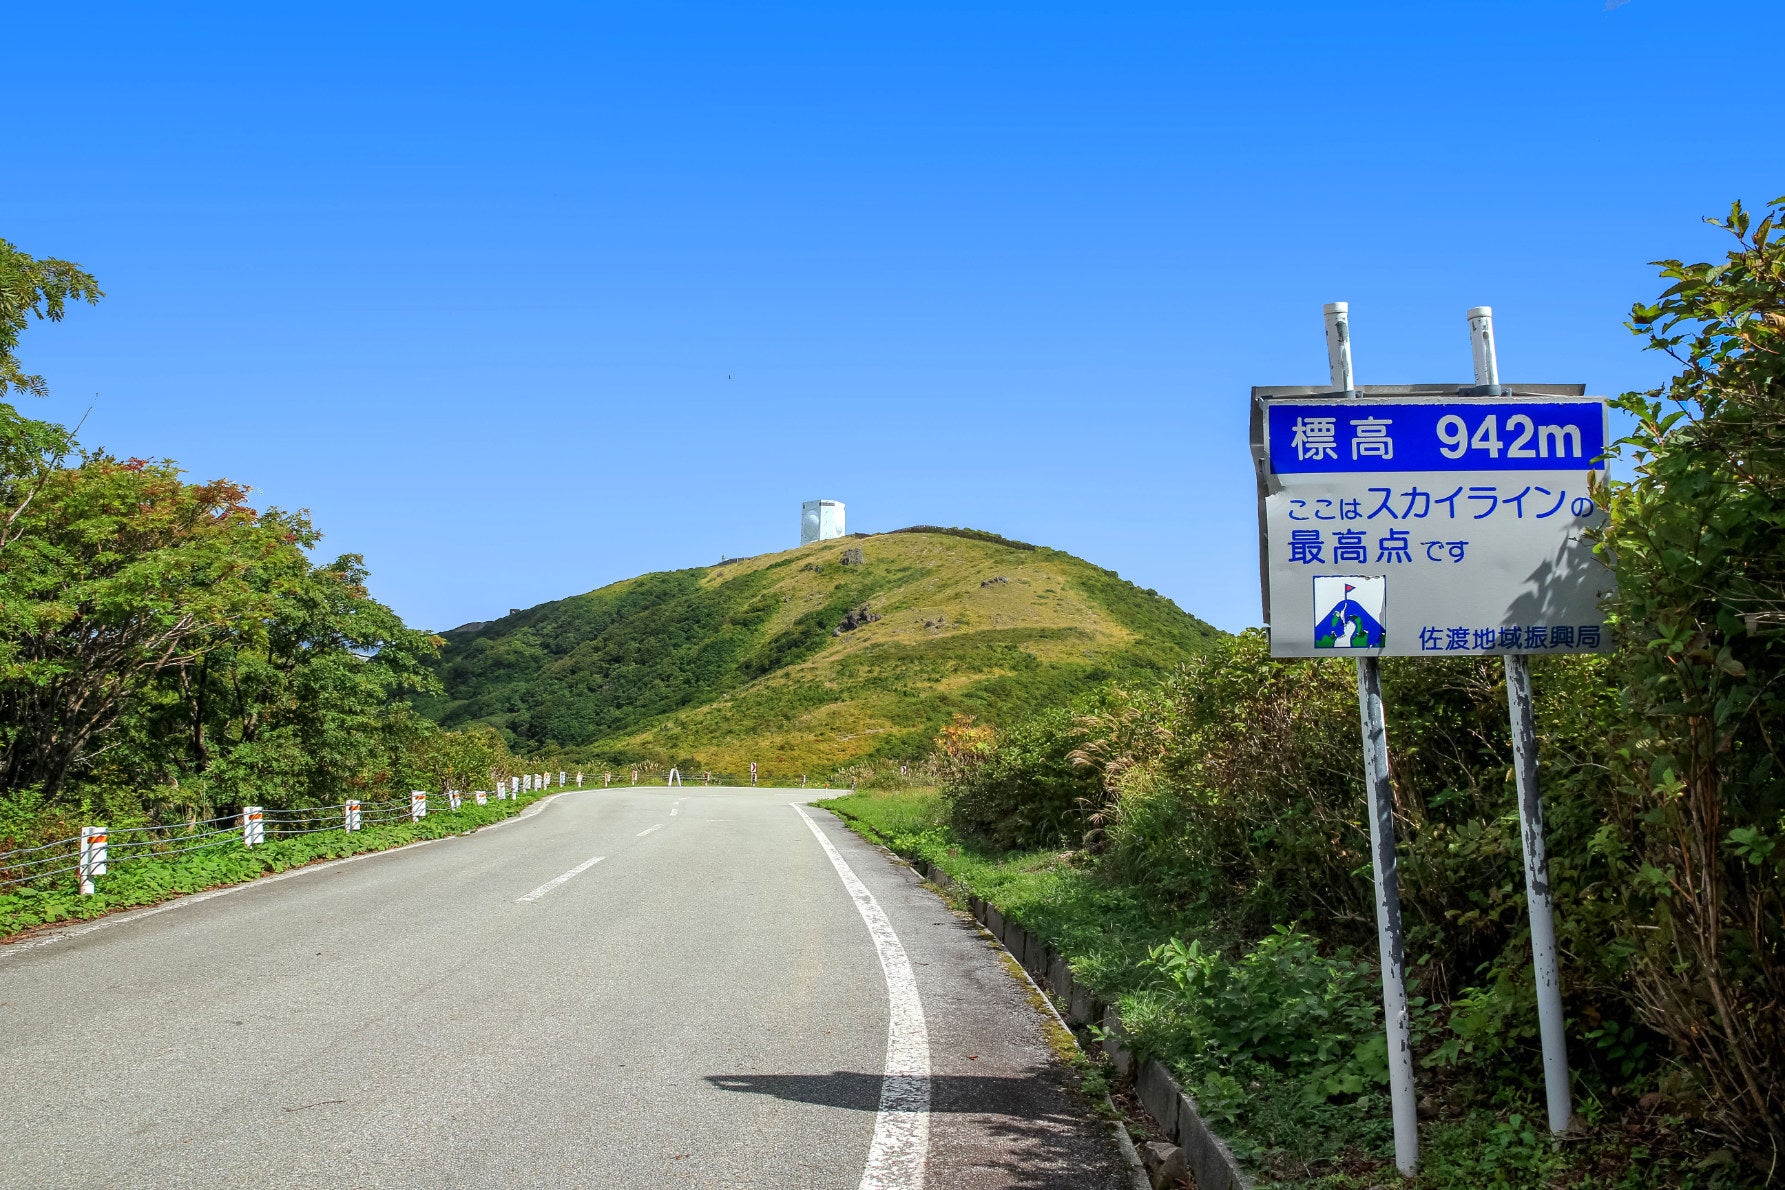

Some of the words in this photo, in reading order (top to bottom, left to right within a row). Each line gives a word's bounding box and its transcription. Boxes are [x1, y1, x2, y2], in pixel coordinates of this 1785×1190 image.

[1291, 416, 1394, 461] 標高
[1436, 414, 1582, 459] 942m
[1288, 486, 1594, 520] ここはスカイラインの
[1288, 528, 1470, 565] 最高点です
[1418, 625, 1601, 652] 佐渡地域振興局
